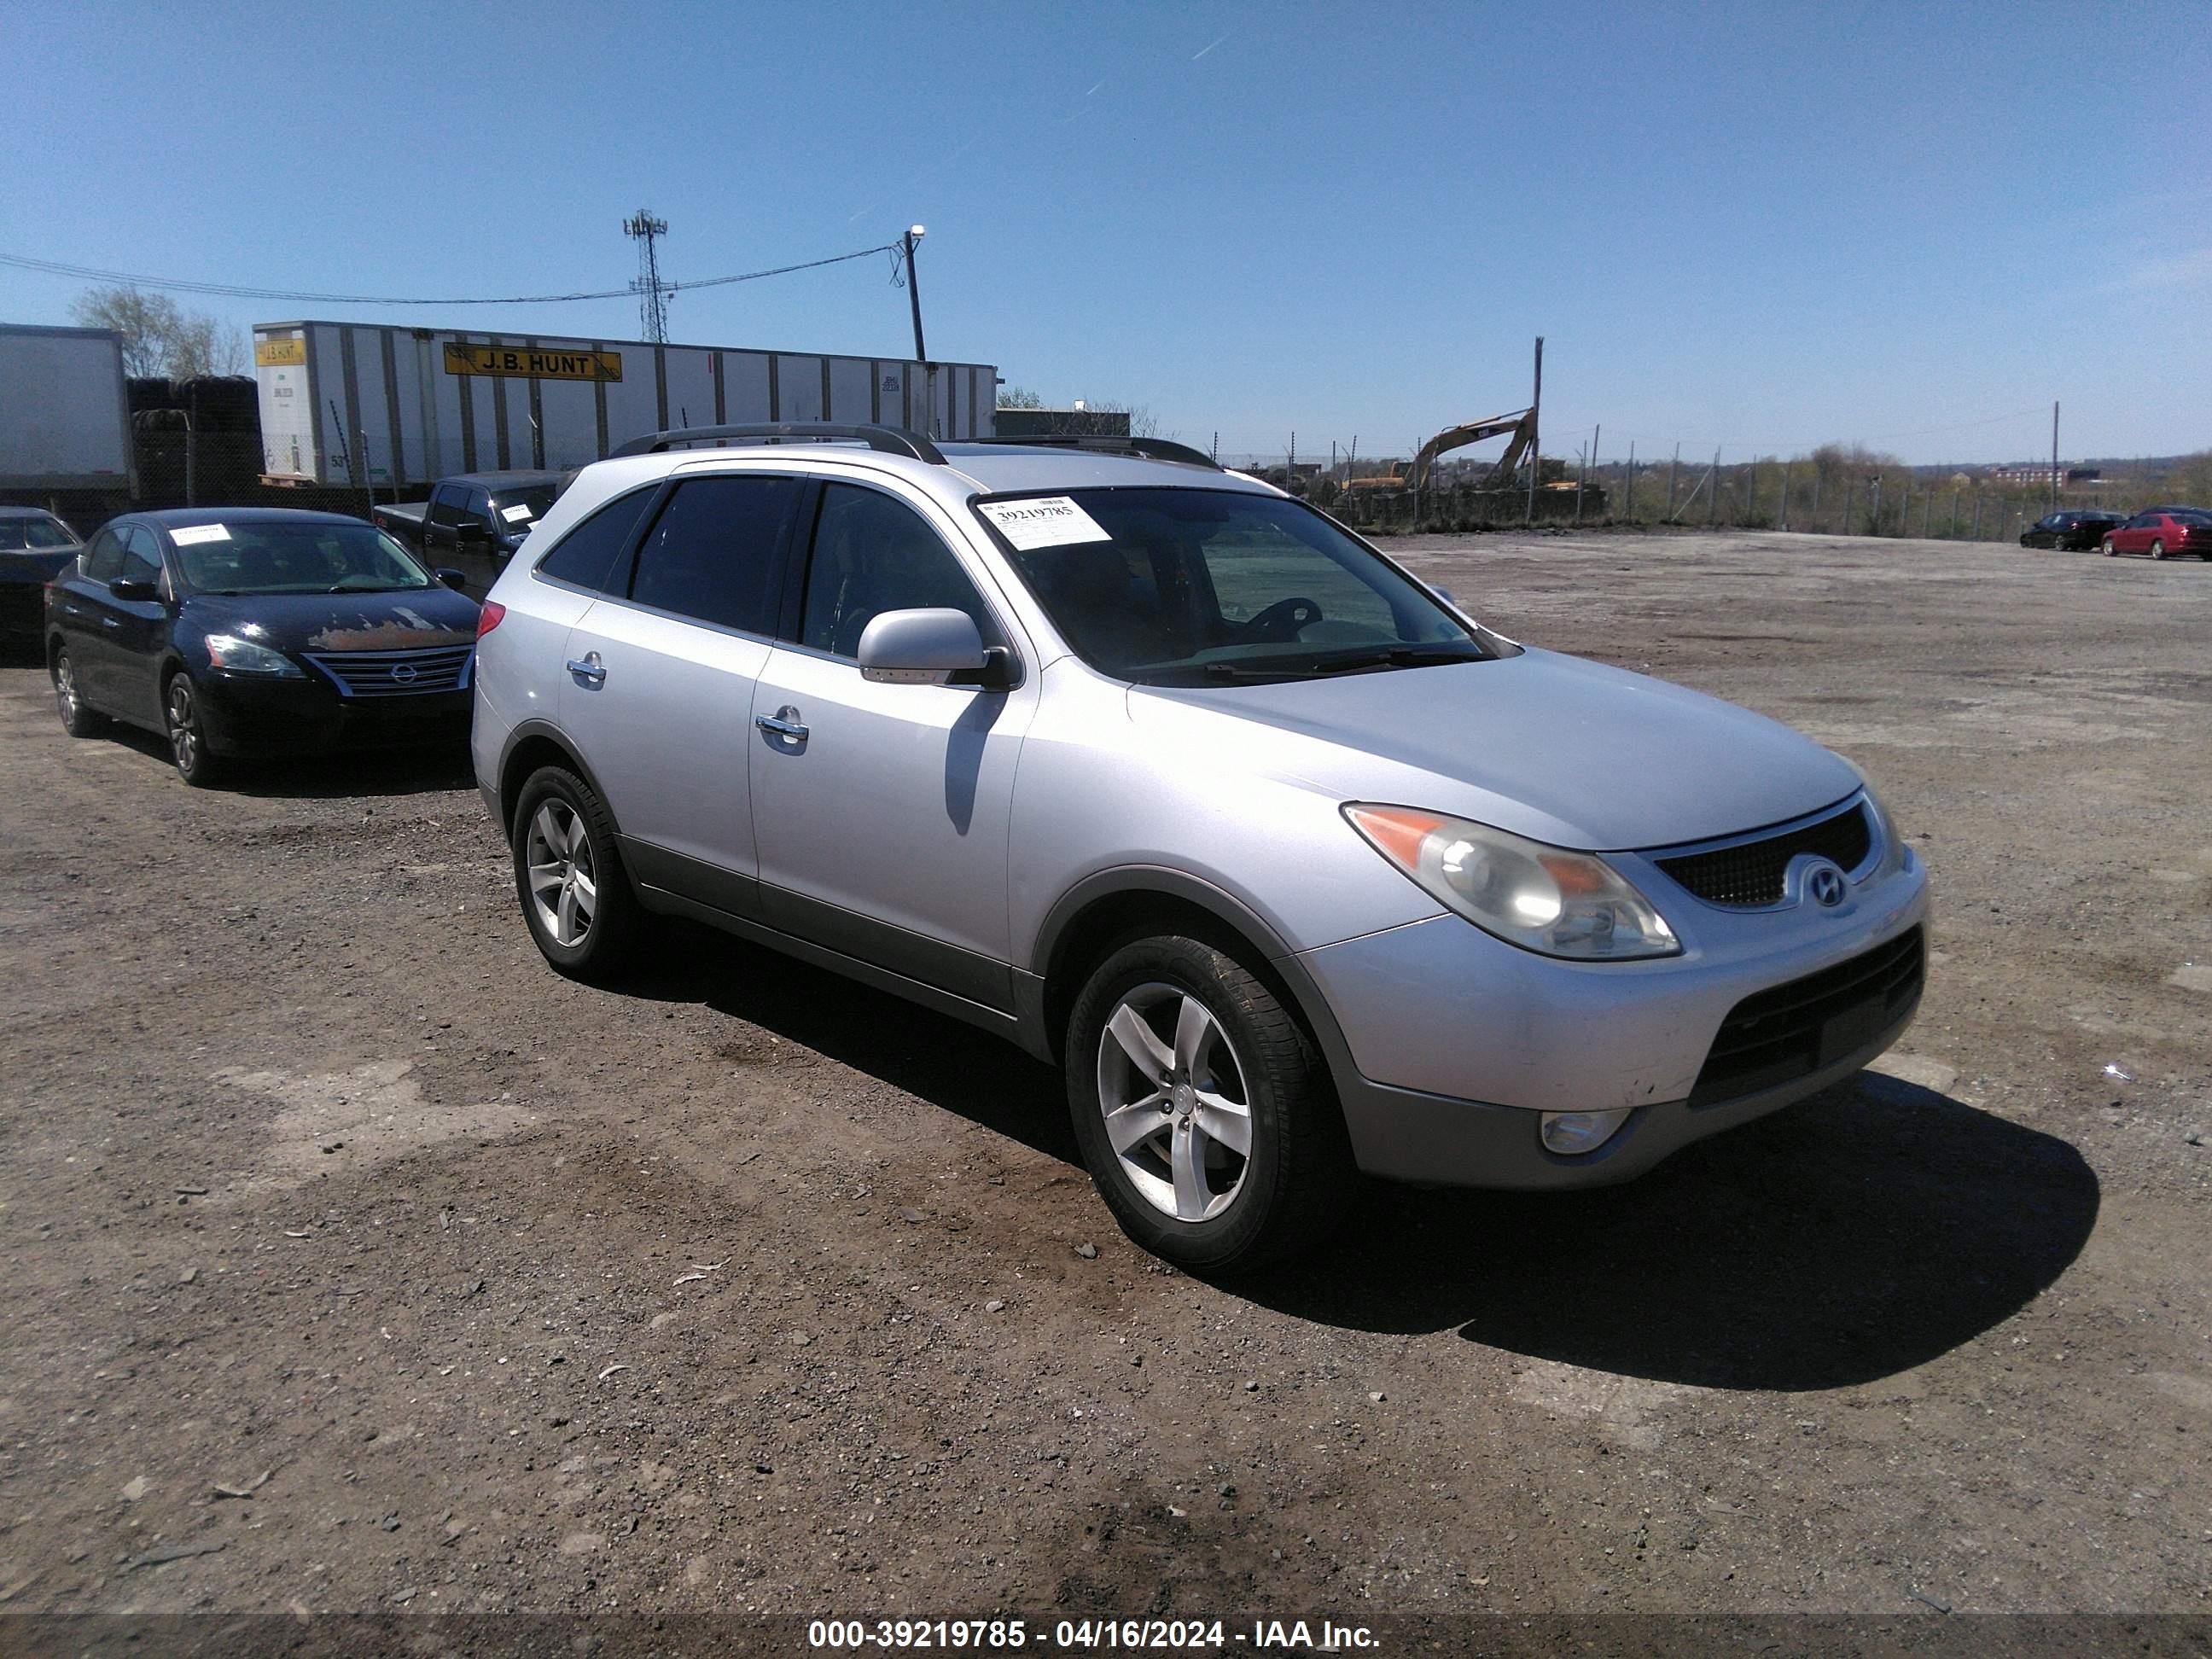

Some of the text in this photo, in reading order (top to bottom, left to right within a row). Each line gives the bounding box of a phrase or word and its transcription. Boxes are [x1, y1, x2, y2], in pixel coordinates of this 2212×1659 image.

[482, 352, 590, 374] J.B. HUNT
[997, 506, 1074, 521] 39219785
